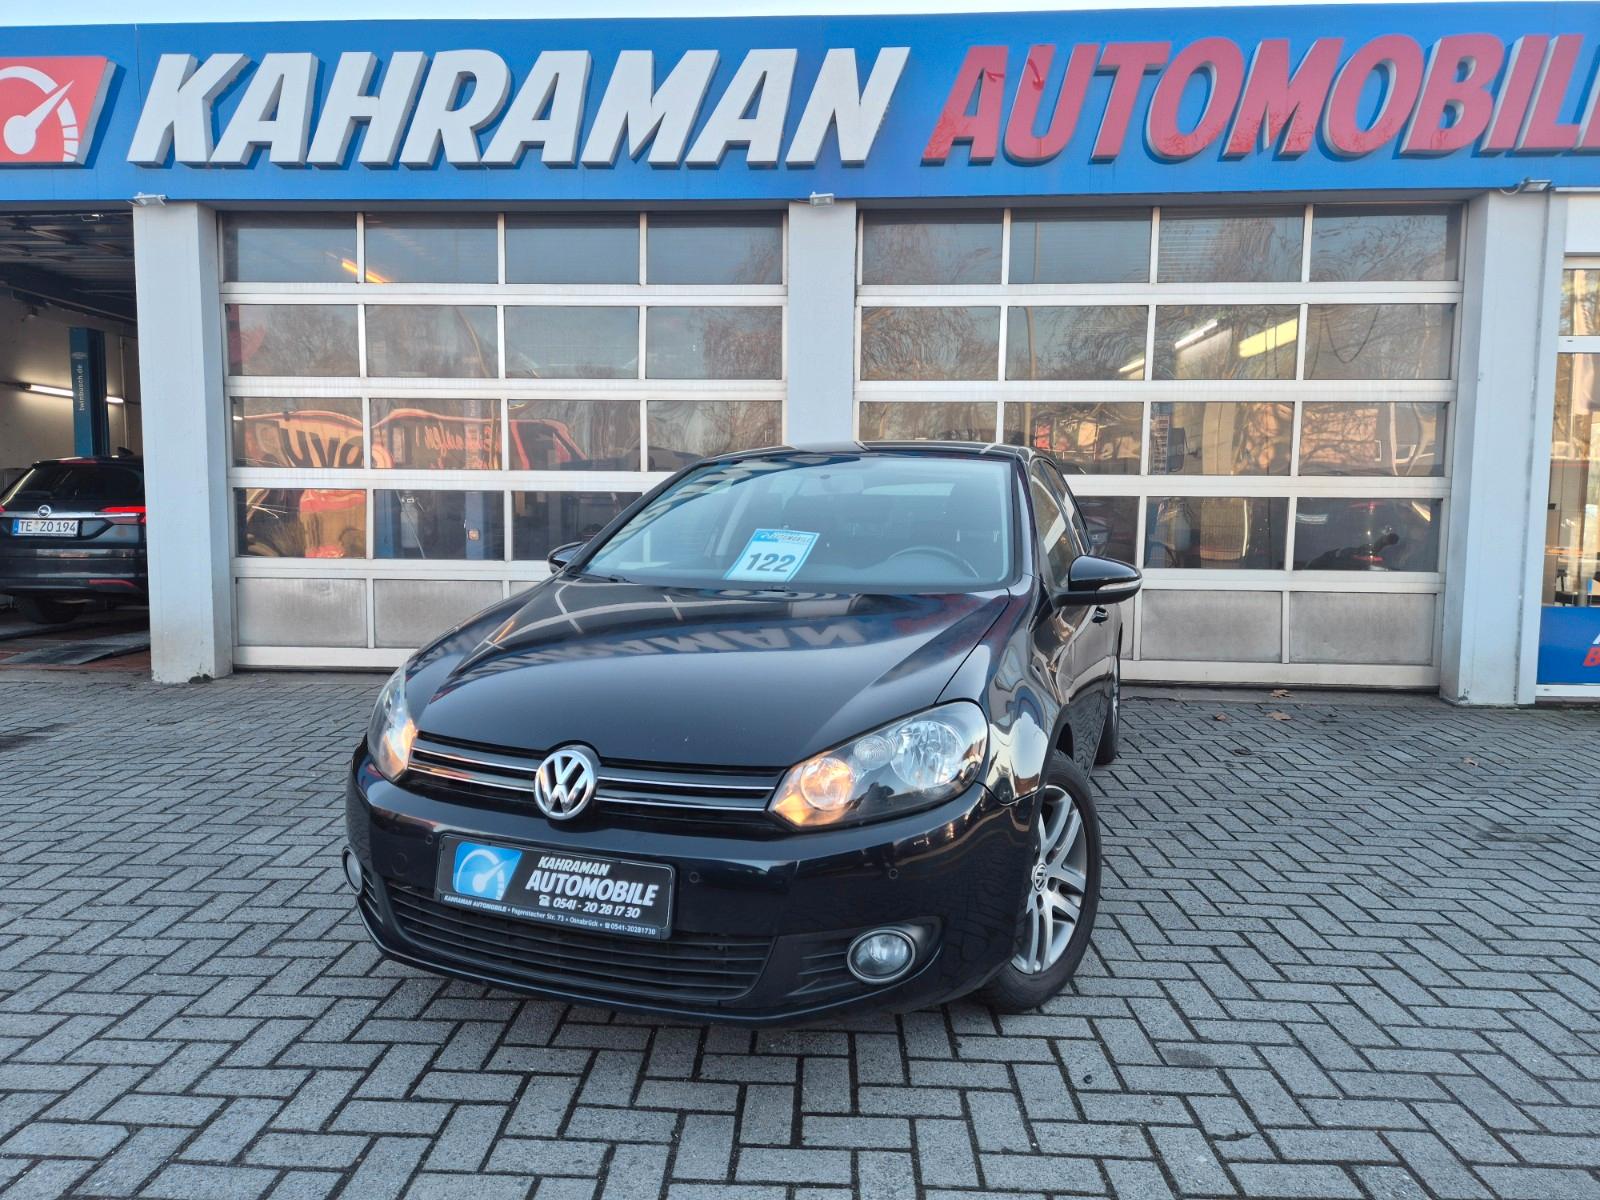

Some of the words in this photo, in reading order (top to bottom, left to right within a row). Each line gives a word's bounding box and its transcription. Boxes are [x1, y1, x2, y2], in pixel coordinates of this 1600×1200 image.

[126, 46, 911, 168] KAHRAMAN
[920, 33, 1600, 167] AUTOMOBIL
[20, 521, 33, 532] TE
[40, 521, 53, 532] ZO
[56, 522, 76, 533] 194
[746, 552, 796, 572] 122
[537, 856, 611, 876] KAHRAMAN
[525, 869, 660, 906] AUTOMOBILE
[443, 895, 473, 906] KAHRAMAN
[569, 916, 599, 928] Osnabrück
[552, 897, 577, 910] 0541
[582, 901, 598, 913] 20
[598, 903, 613, 915] 28
[613, 905, 626, 916] 17
[624, 907, 641, 919] 30
